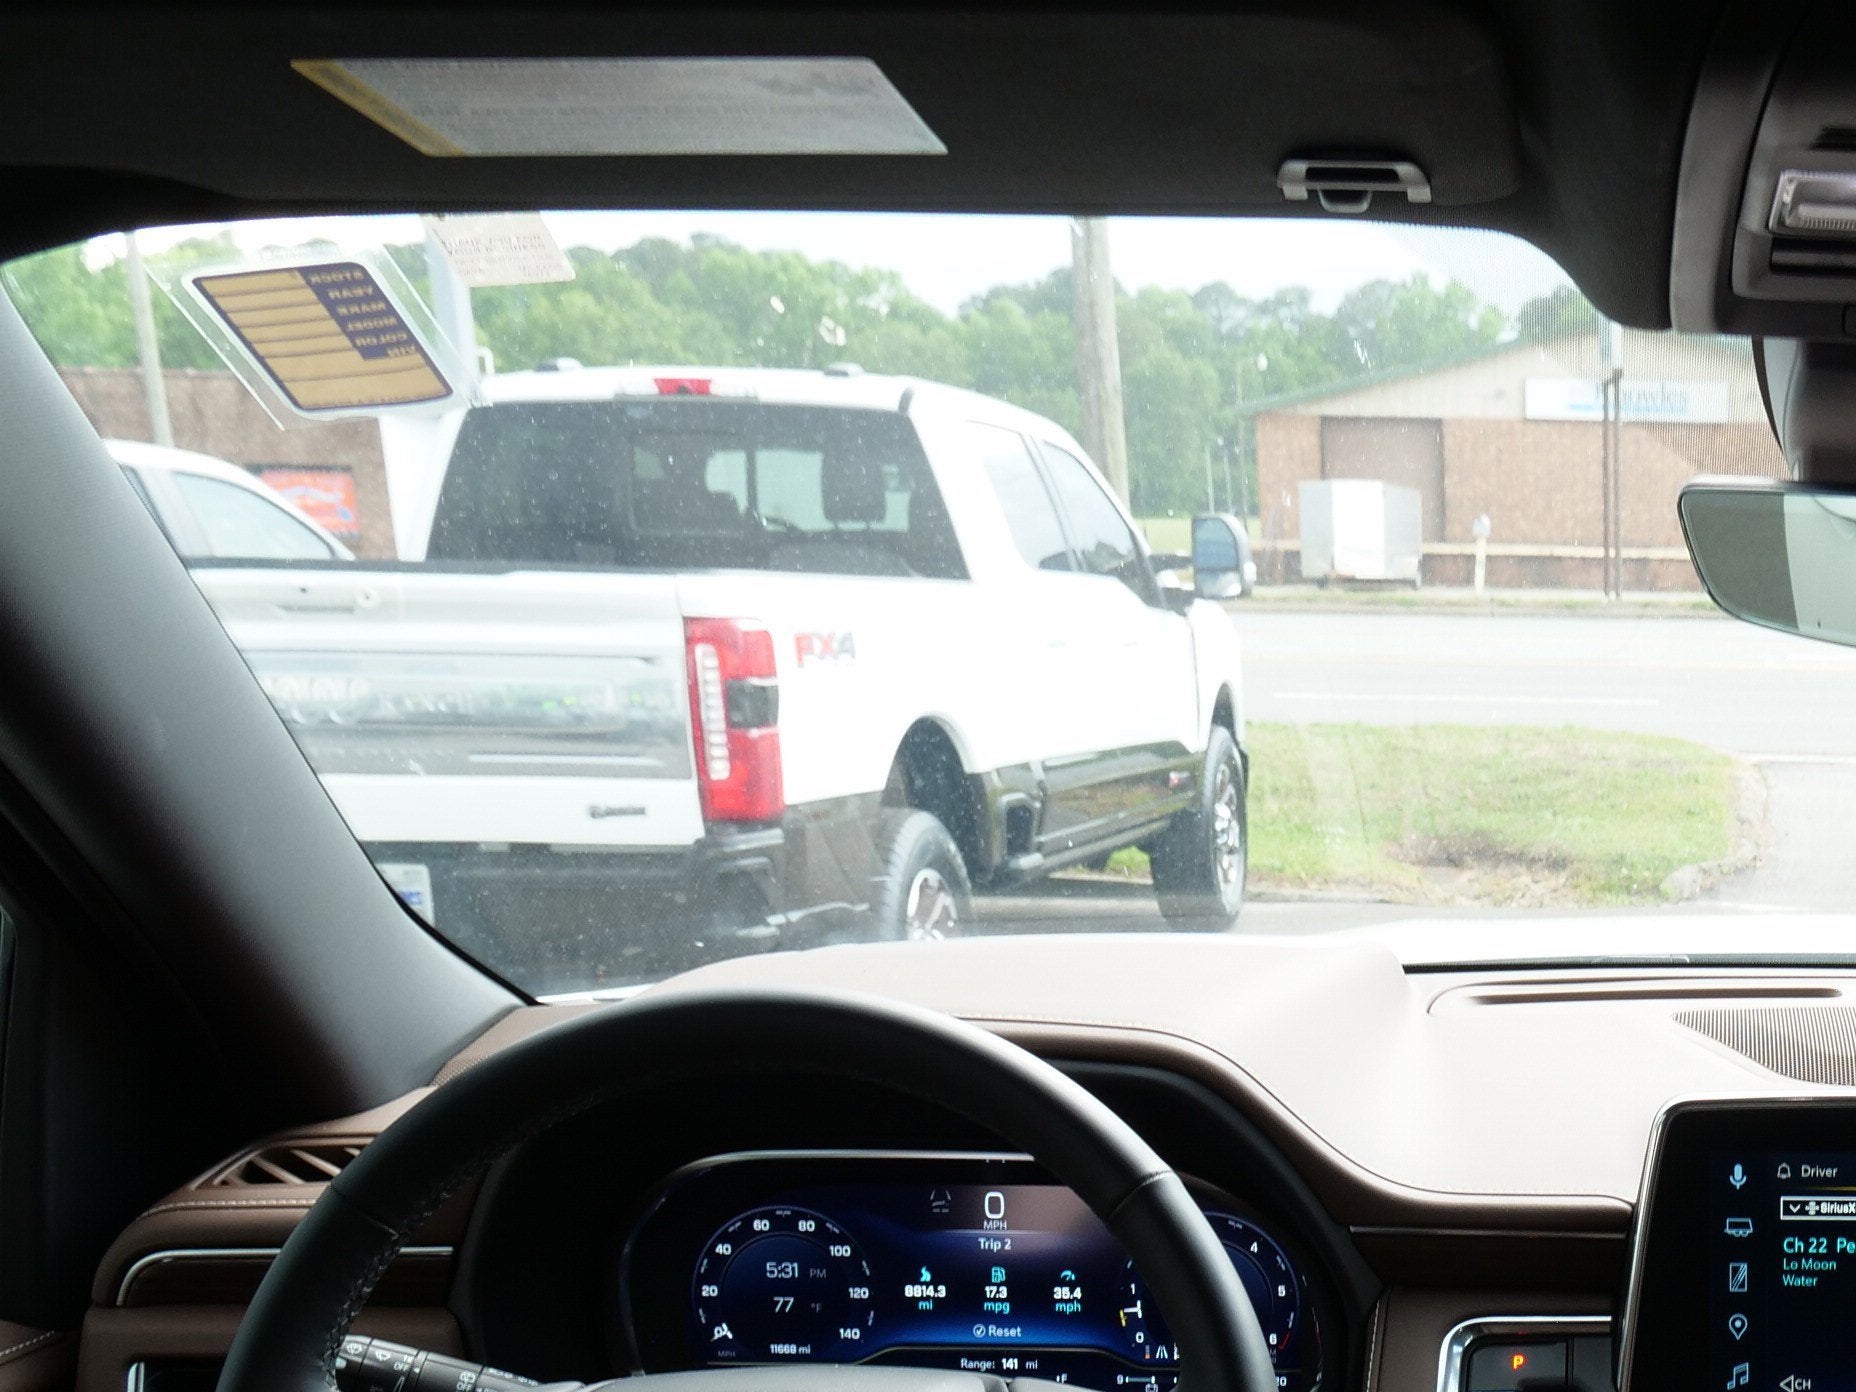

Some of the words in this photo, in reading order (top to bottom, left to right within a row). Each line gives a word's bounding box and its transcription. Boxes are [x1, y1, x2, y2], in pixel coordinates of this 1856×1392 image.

[1801, 1165, 1838, 1178] Driver
[984, 1191, 1005, 1219] 0
[753, 1219, 770, 1232] 60
[798, 1220, 815, 1232] 80
[983, 1220, 1007, 1231] MPH
[715, 1243, 732, 1255] 40
[829, 1245, 851, 1257] 100
[978, 1237, 1002, 1252] Trip
[1004, 1238, 1012, 1250] 2
[1250, 1241, 1258, 1254] 4
[1783, 1237, 1804, 1254] Ch
[1808, 1238, 1827, 1254] 22
[766, 1262, 799, 1279] 5:31
[809, 1268, 827, 1279] PM
[1783, 1258, 1798, 1270] Lo
[1801, 1258, 1837, 1270] Moon
[1783, 1275, 1818, 1286] Water
[701, 1285, 718, 1297] 20
[848, 1287, 869, 1299] 120
[985, 1286, 1008, 1299] 17.3
[1053, 1286, 1082, 1300] 35.4
[1130, 1283, 1136, 1295] 1
[773, 1296, 794, 1313] 77
[918, 1299, 933, 1311] mi
[984, 1301, 1010, 1315] mpg
[1055, 1300, 1082, 1315] mph
[839, 1328, 860, 1340] 140
[988, 1325, 1022, 1337] Reset
[1135, 1331, 1144, 1344] 0
[1269, 1333, 1277, 1346] 6
[798, 1344, 811, 1354] mi
[960, 1358, 996, 1371] Range:
[1001, 1358, 1019, 1370] 141
[1025, 1359, 1038, 1370] mi
[1512, 1355, 1525, 1370] P
[1794, 1378, 1811, 1391] CH
